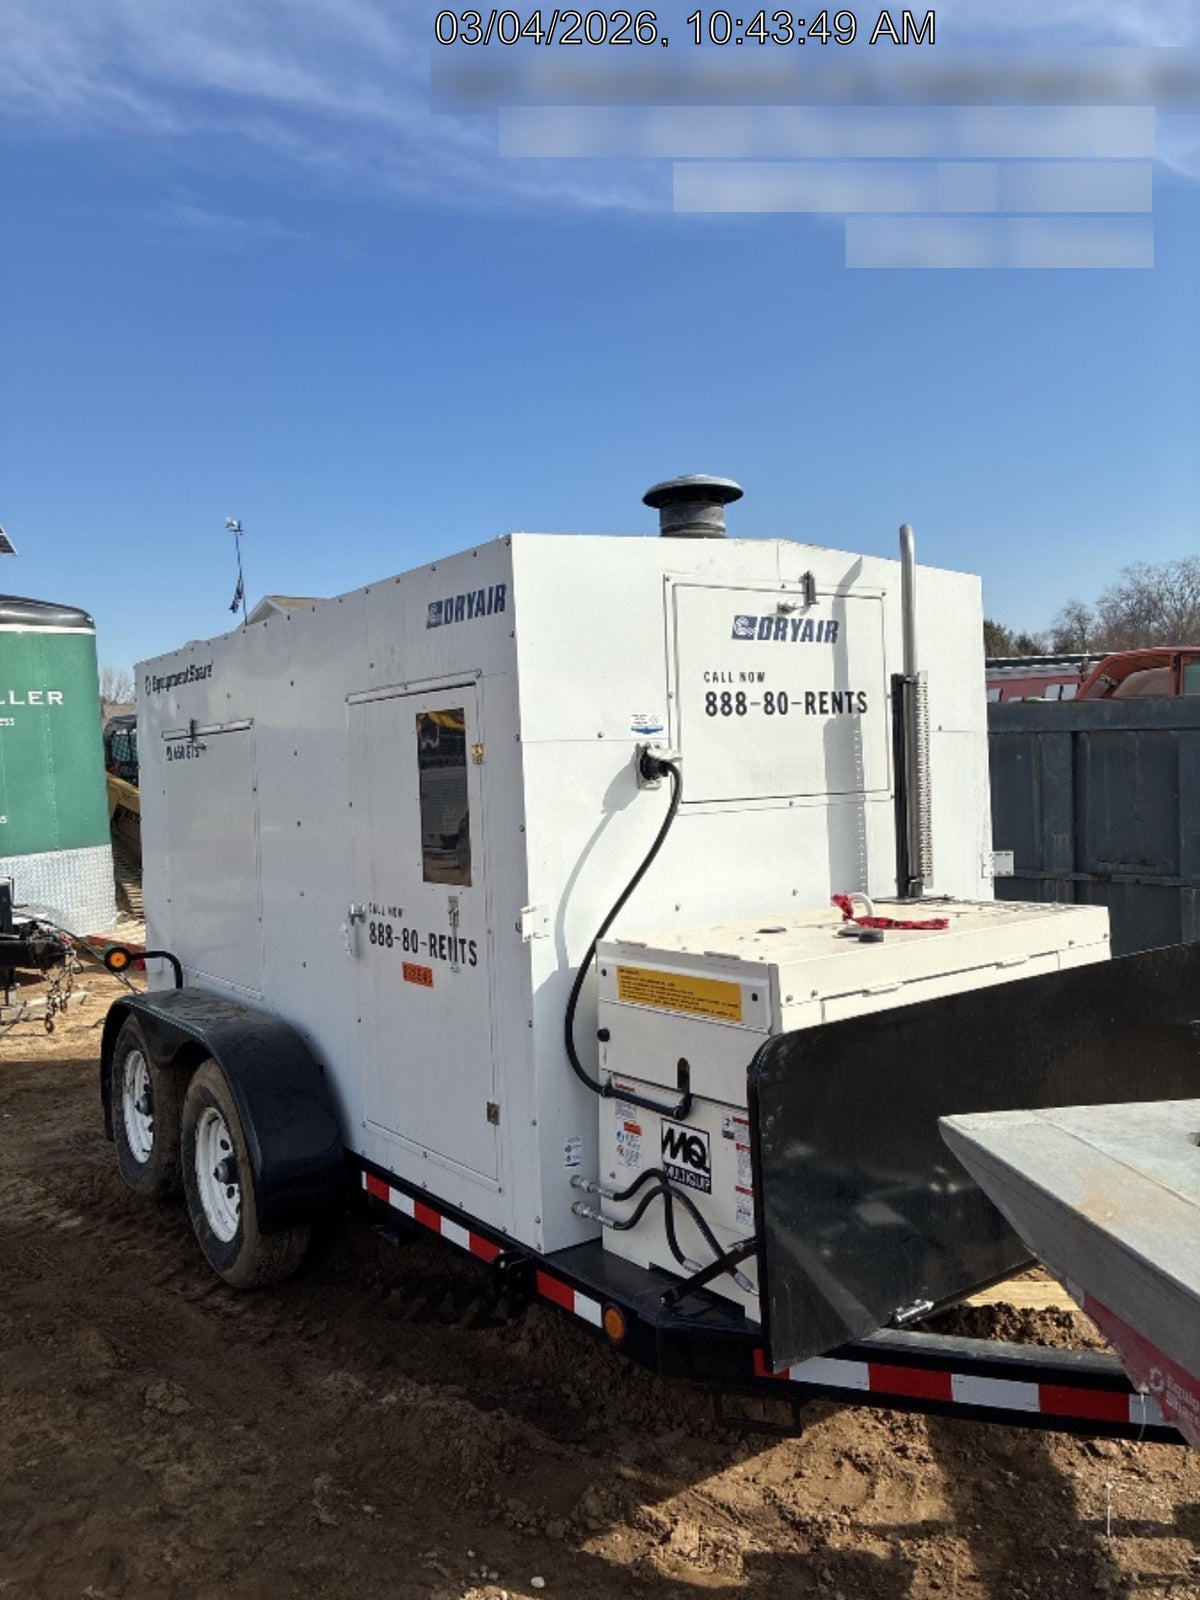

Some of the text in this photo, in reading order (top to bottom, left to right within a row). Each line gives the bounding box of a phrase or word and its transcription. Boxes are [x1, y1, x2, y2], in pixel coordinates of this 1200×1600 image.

[444, 584, 507, 625] DRYAIR
[757, 616, 839, 644] DRYAIR
[704, 671, 766, 684] CALL NOW
[705, 691, 868, 717] 888-80-RENTS
